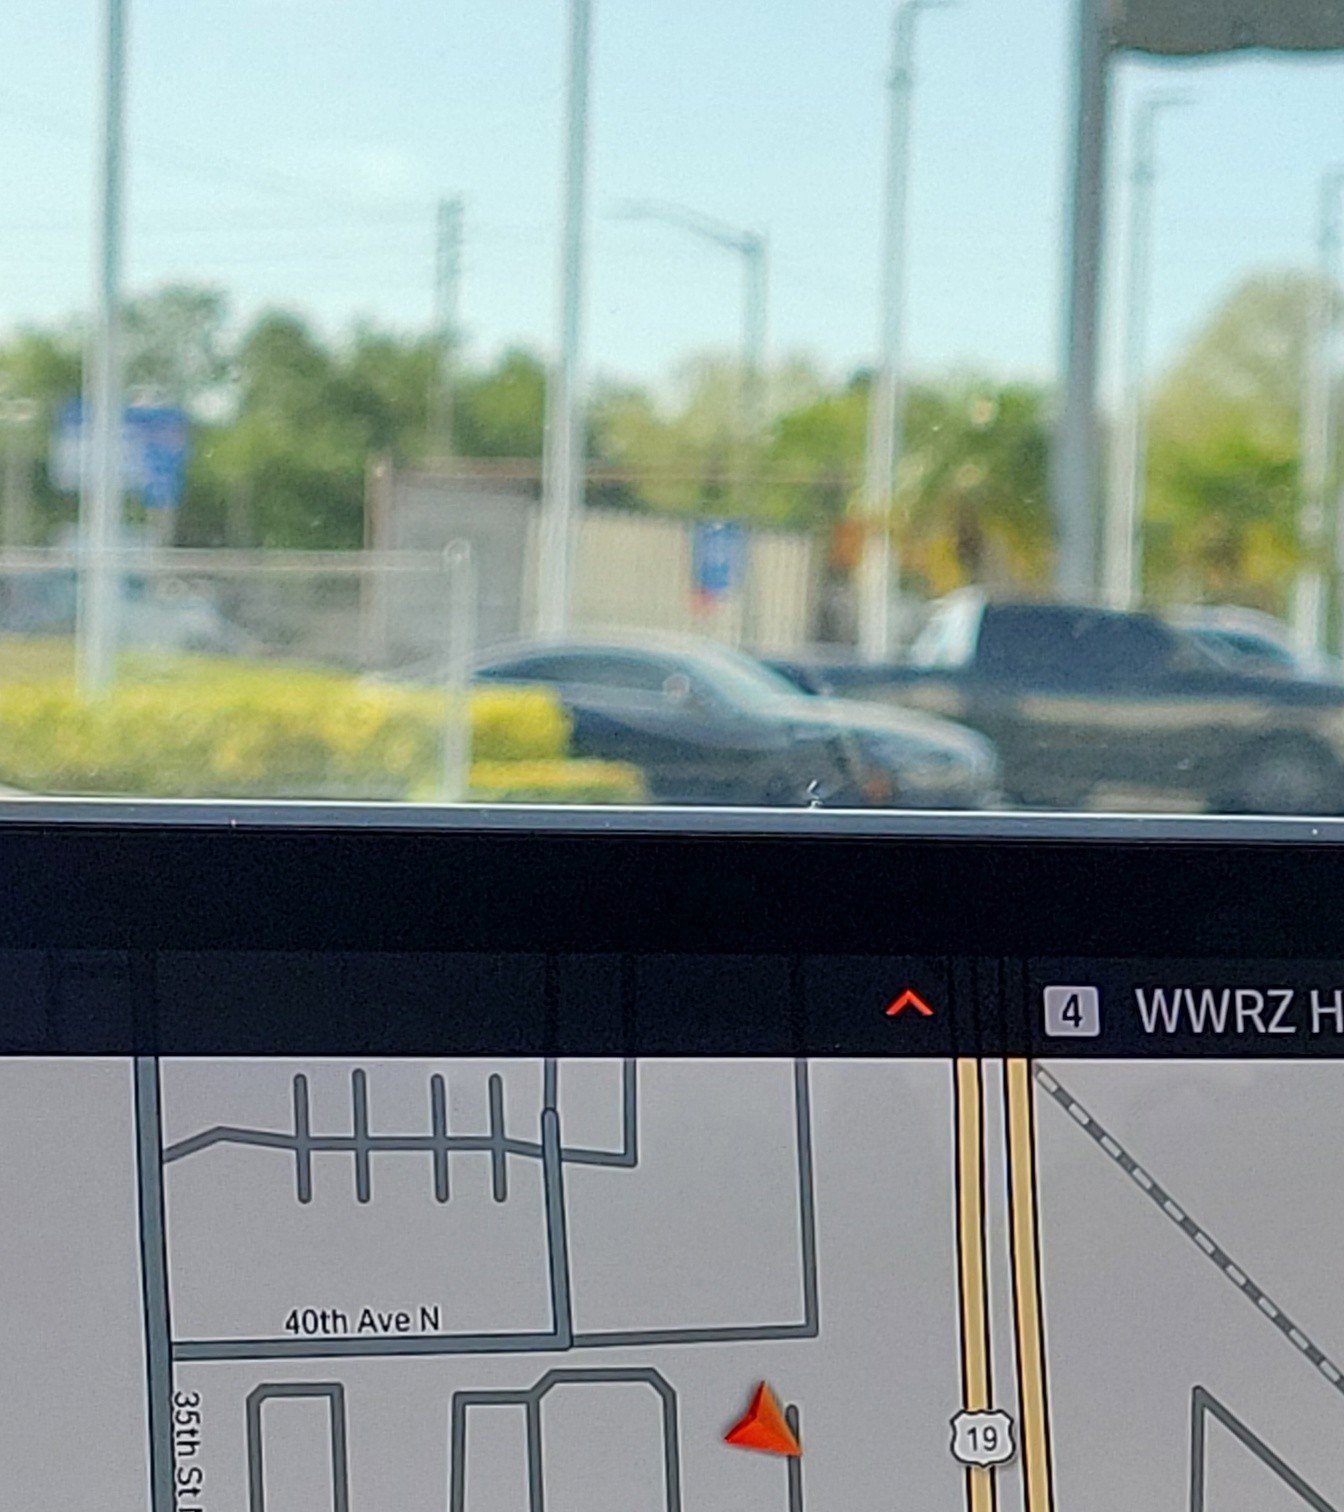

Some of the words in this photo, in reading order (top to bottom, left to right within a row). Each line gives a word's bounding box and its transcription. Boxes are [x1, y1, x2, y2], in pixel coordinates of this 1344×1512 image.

[1062, 993, 1083, 1028] 4
[1134, 988, 1297, 1035] WWRZ
[285, 1309, 349, 1335] 40th
[357, 1309, 412, 1333] Ave
[420, 1306, 440, 1330] N
[173, 1391, 202, 1457] 35th
[967, 1426, 999, 1451] 19
[176, 1466, 203, 1498] St
